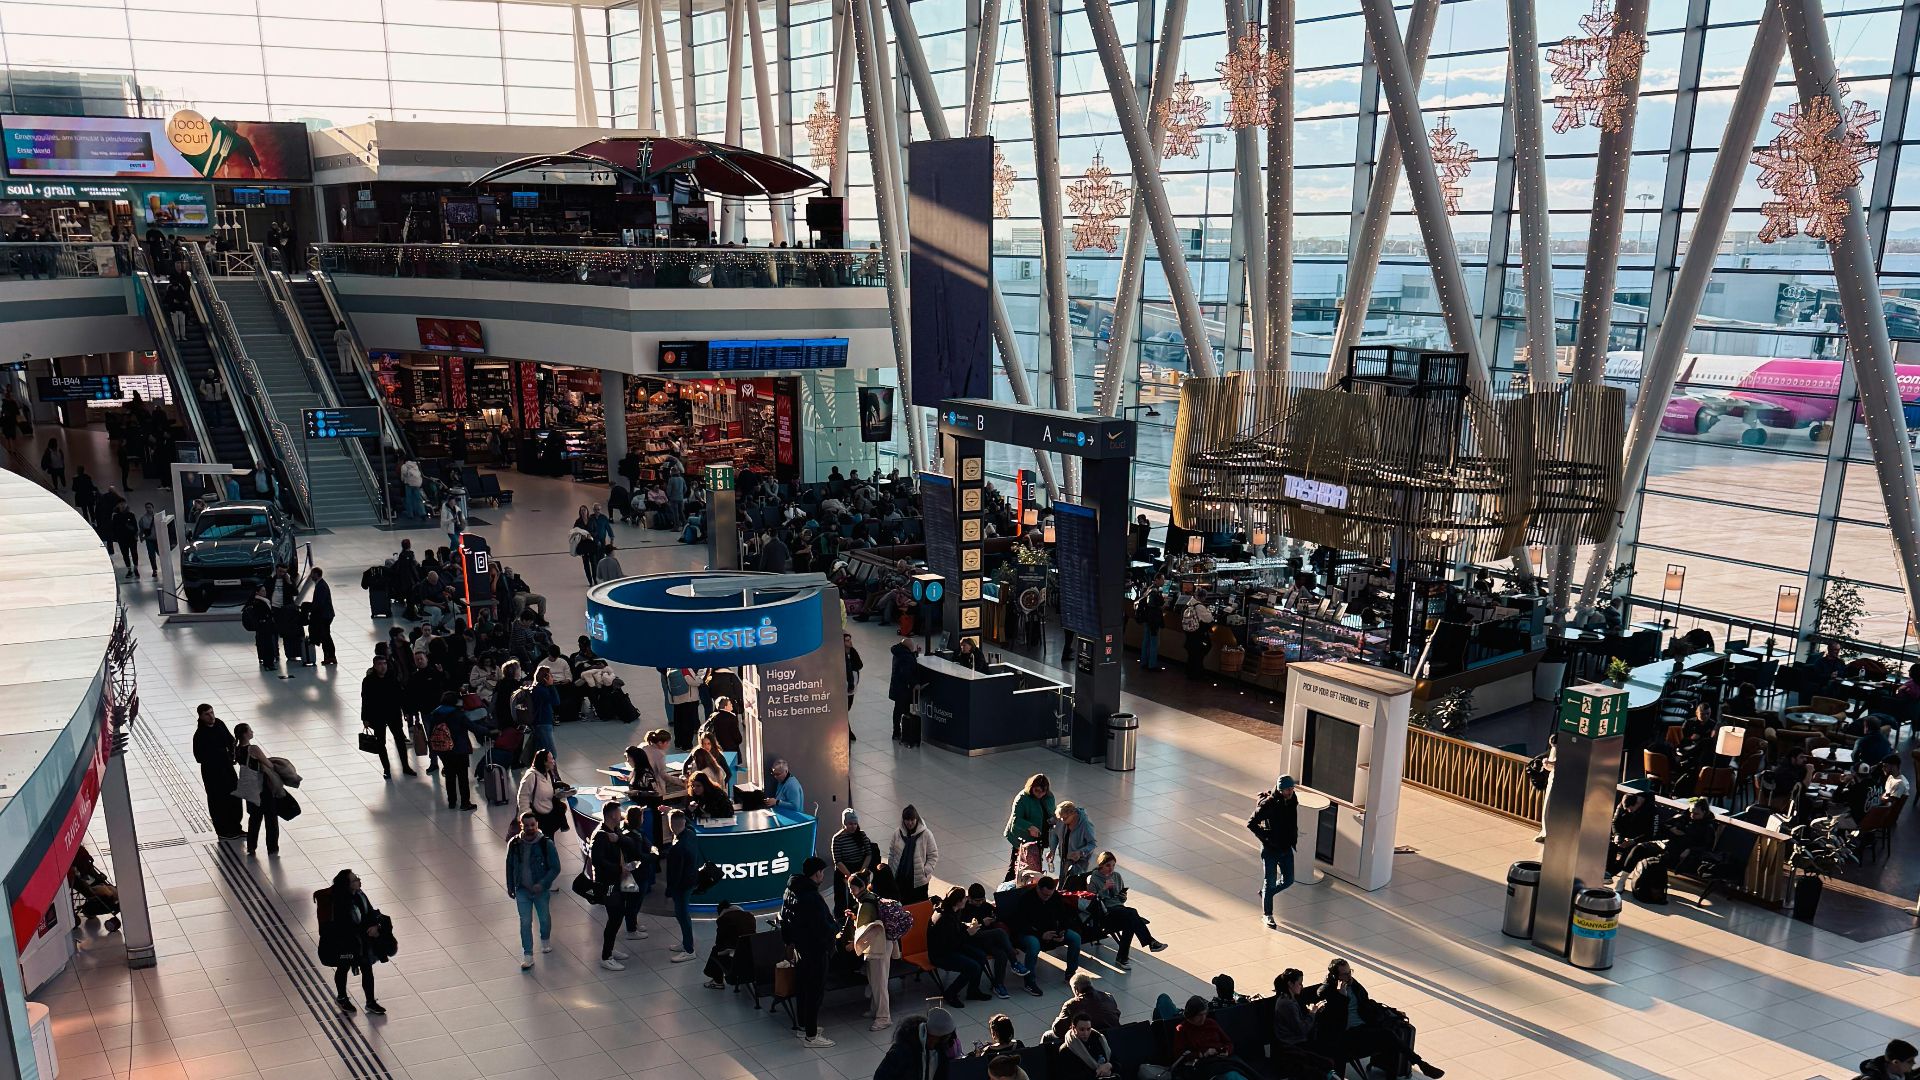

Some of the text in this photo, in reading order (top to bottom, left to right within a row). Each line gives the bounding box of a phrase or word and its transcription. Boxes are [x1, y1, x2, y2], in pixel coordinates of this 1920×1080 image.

[174, 117, 205, 130] food
[174, 132, 208, 144] court
[7, 184, 33, 196] soul
[43, 184, 76, 197] grain
[977, 414, 984, 431] B
[1043, 425, 1052, 443] A
[693, 628, 756, 651] ERSTE
[766, 669, 796, 681] Higgy
[767, 678, 823, 693] magadban!
[767, 691, 831, 705] Az Erste már
[1302, 682, 1312, 691] PICK
[1312, 685, 1319, 693] UP
[1318, 686, 1329, 697] YOUR
[1329, 689, 1339, 700] GIFT
[1358, 699, 1370, 710] HERE
[767, 703, 831, 718] hisz benned.
[715, 860, 769, 880] RSTE
